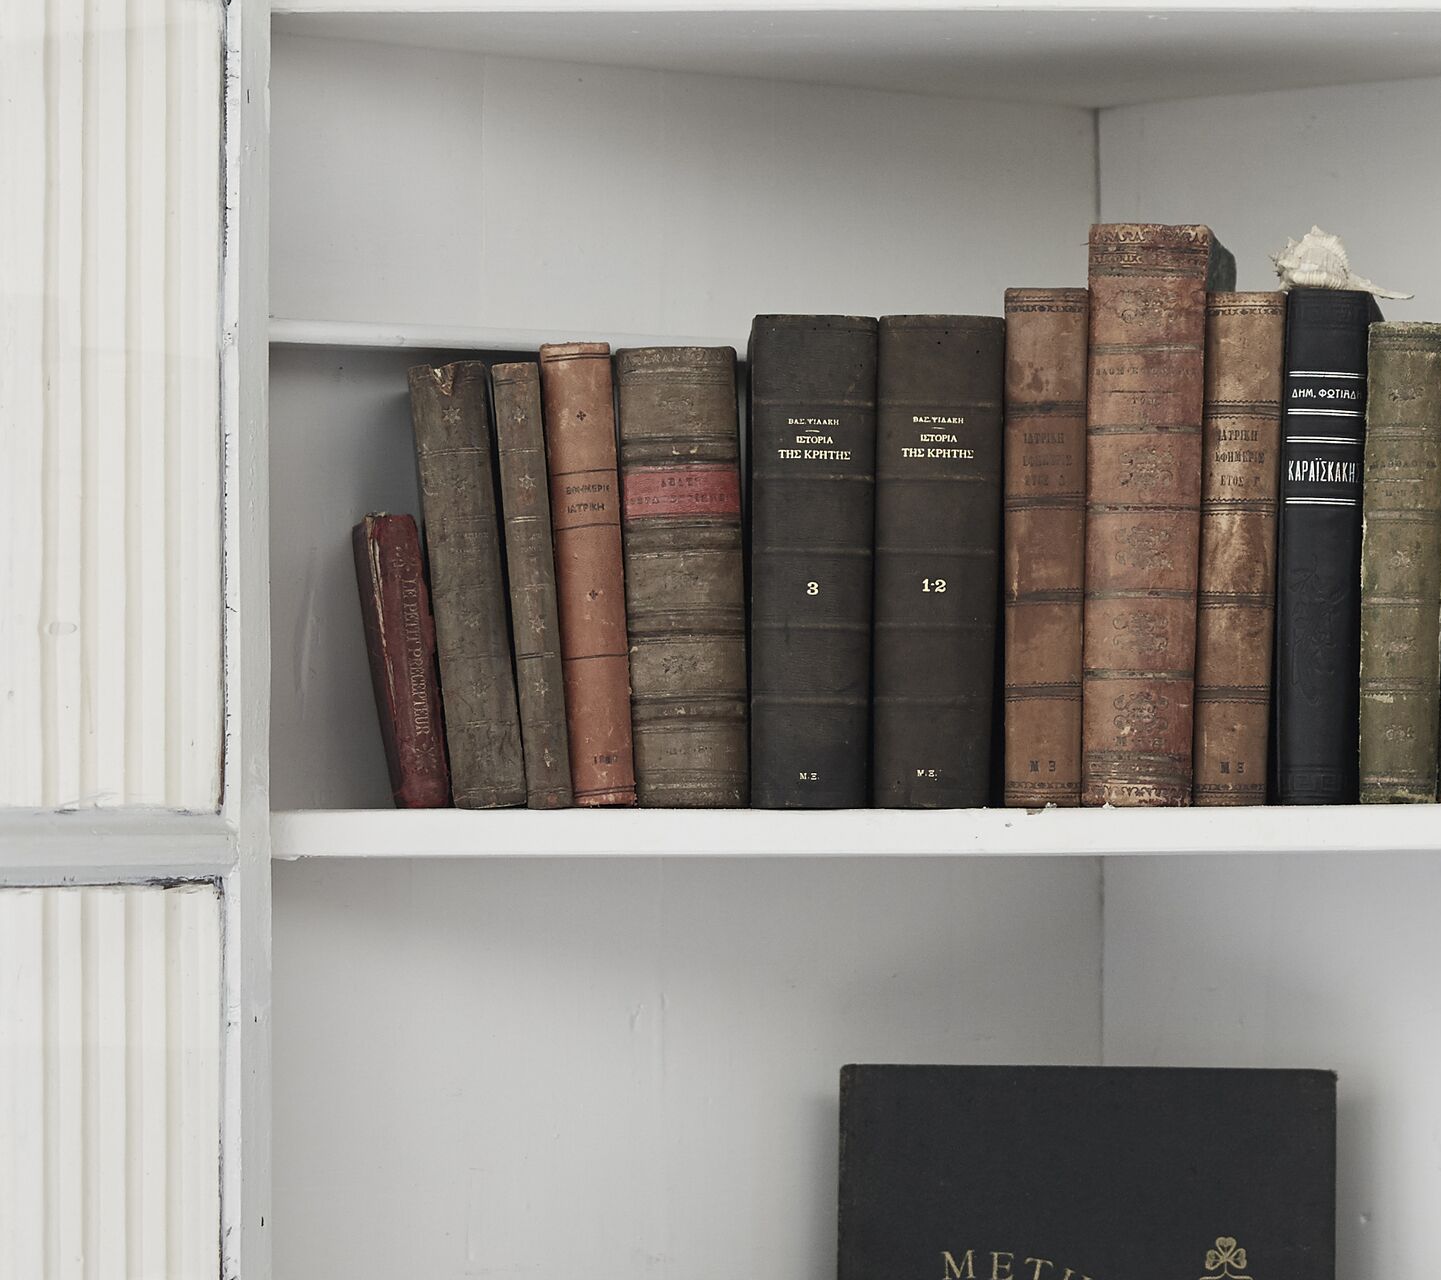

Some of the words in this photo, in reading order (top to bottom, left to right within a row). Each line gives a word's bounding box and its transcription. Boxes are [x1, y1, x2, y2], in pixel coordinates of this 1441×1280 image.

[1292, 389, 1316, 398] ΔΗΜ.
[796, 436, 833, 444] ΙΣΤΟΡΙΑ
[920, 434, 957, 442] ΙΣΤΟΡΙΑ
[778, 450, 801, 459] ΤΗΣ
[804, 450, 850, 460] ΚΡΗΤΗΣ
[901, 448, 924, 458] ΤΗΣ
[927, 448, 974, 459] ΚΡΗΤΗΣ
[807, 582, 819, 595] 3
